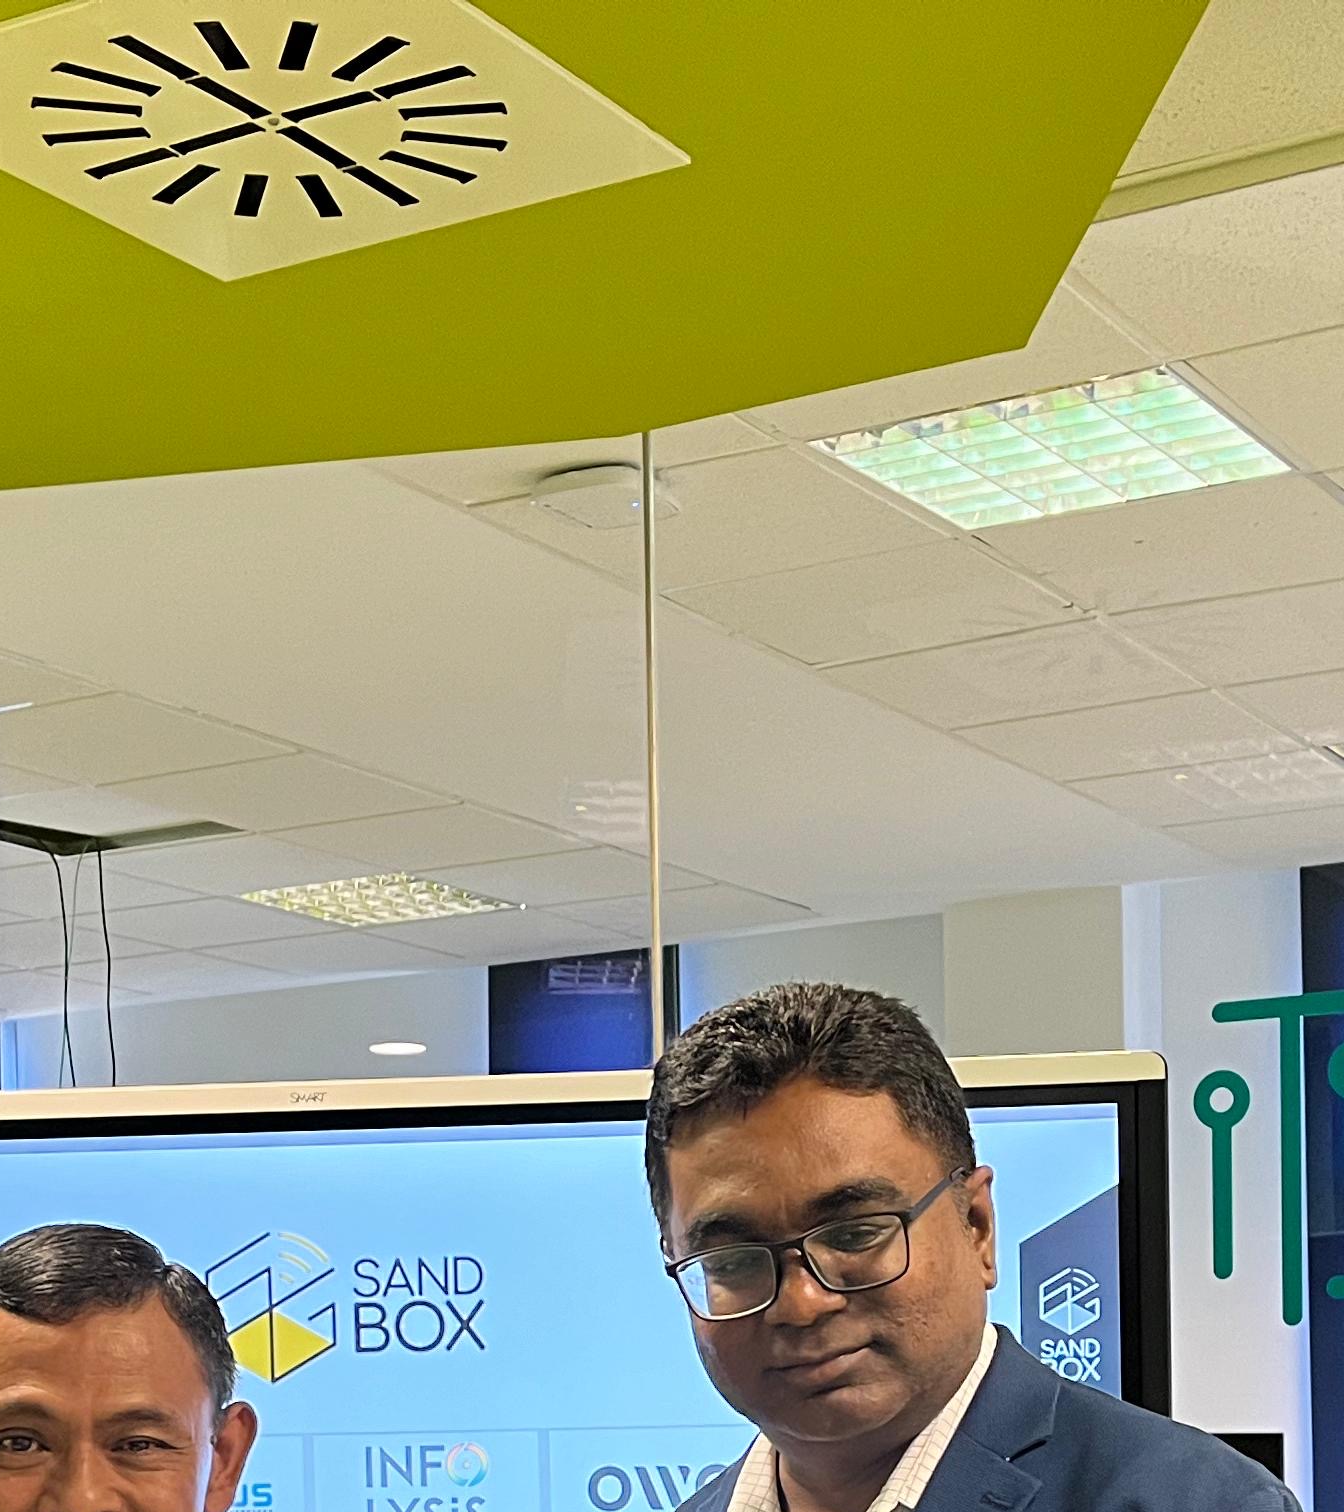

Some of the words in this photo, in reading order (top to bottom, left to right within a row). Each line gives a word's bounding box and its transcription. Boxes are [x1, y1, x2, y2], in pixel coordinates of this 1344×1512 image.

[289, 1092, 327, 1103] SMART
[353, 1256, 483, 1297] SAND
[354, 1299, 485, 1352] BOX
[1040, 1338, 1101, 1359] SAND
[365, 1442, 489, 1488] INFO
